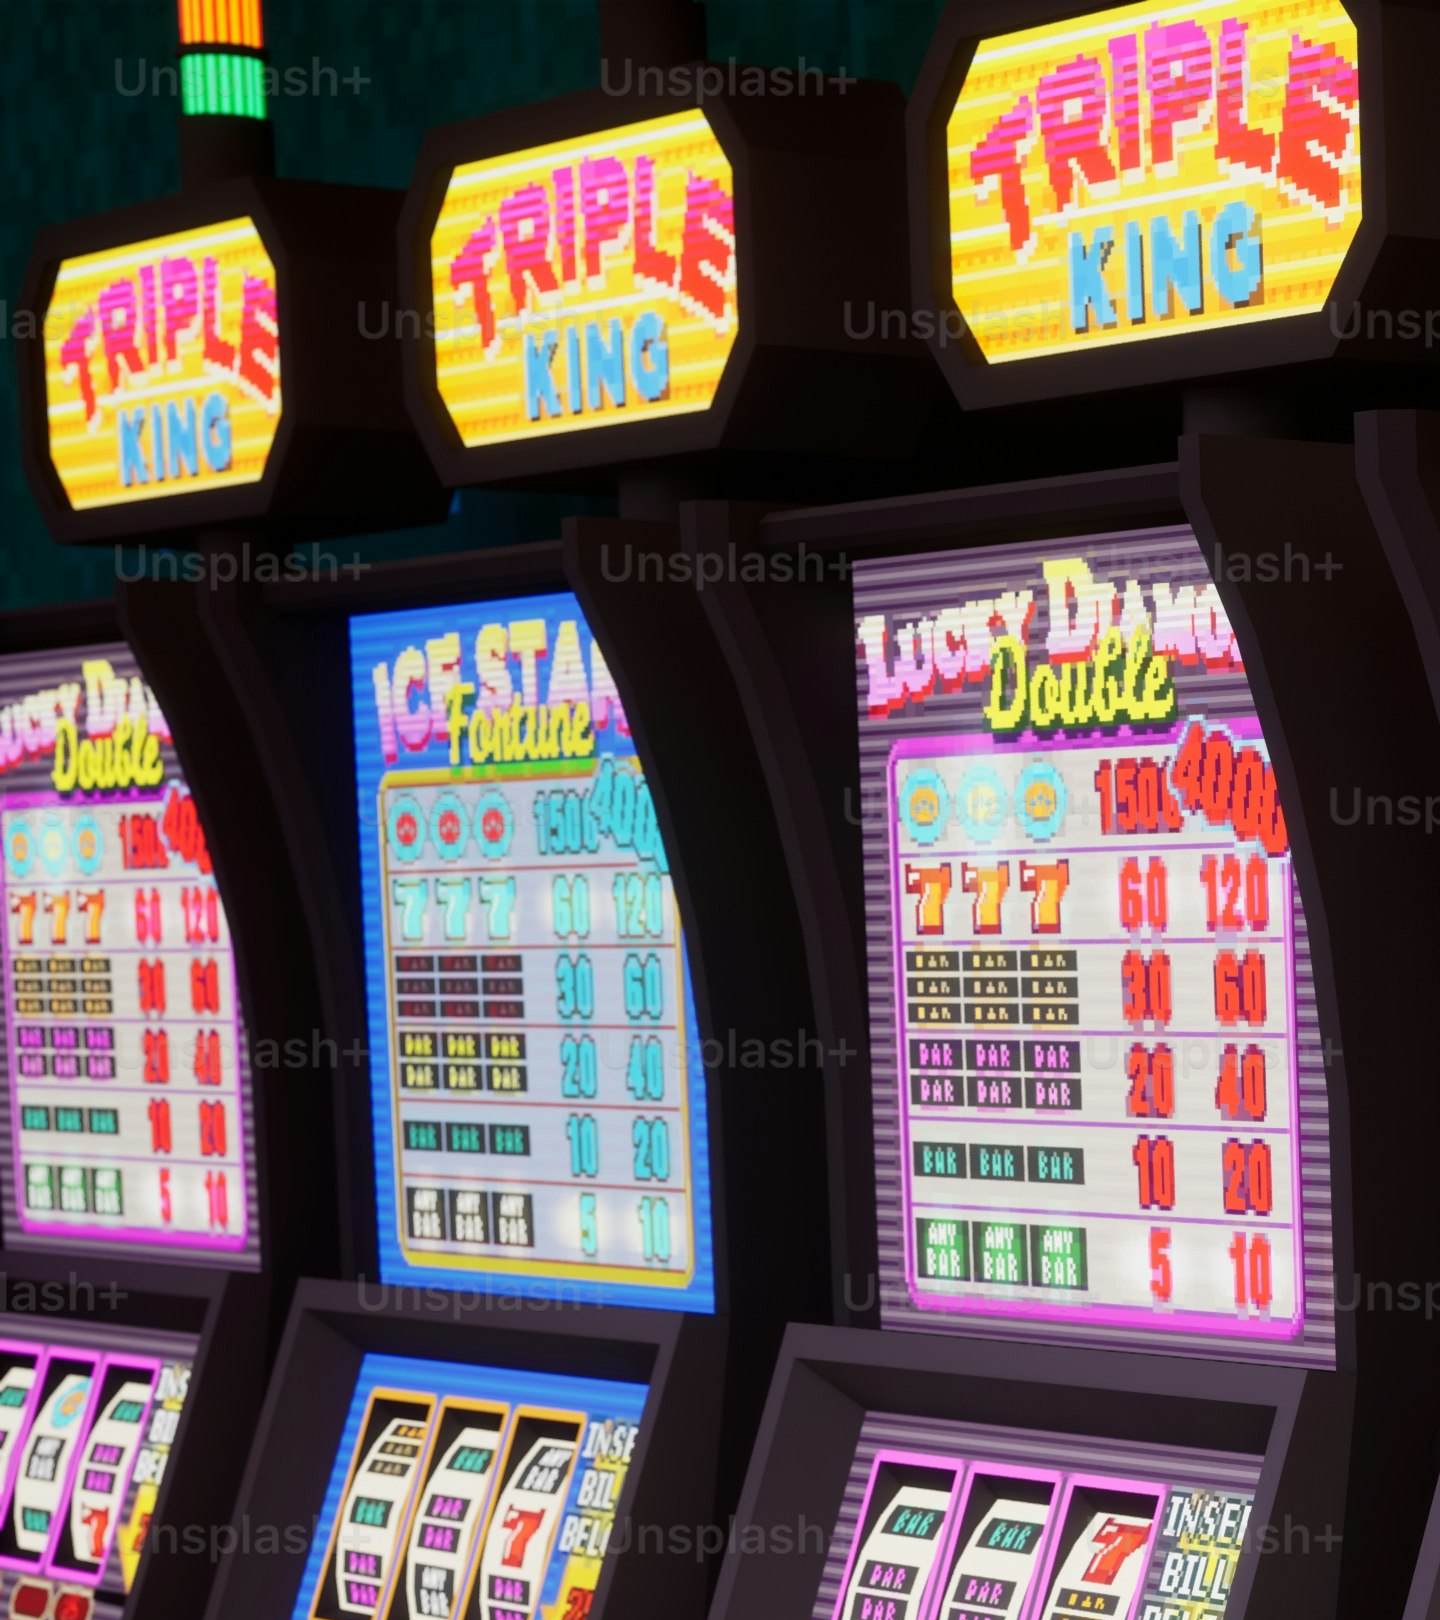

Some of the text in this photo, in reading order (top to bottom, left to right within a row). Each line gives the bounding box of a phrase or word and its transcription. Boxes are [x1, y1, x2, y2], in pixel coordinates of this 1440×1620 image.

[971, 18, 1358, 264] TRIPLE
[450, 155, 736, 362] TRIPLE
[1069, 200, 1265, 334] KING
[60, 257, 280, 432] TRIPLE
[524, 313, 669, 422] KING
[118, 394, 232, 487] KING
[373, 619, 632, 765] ICE STA
[449, 682, 594, 765] Fortune
[984, 625, 1175, 730] Double
[1119, 853, 1269, 932] 60 120
[1122, 949, 1171, 1026] 30
[1214, 948, 1267, 1027] 60
[561, 1034, 663, 1100] 20 40
[1163, 1496, 1251, 1539] INSE
[1159, 1552, 1231, 1601] BILL
